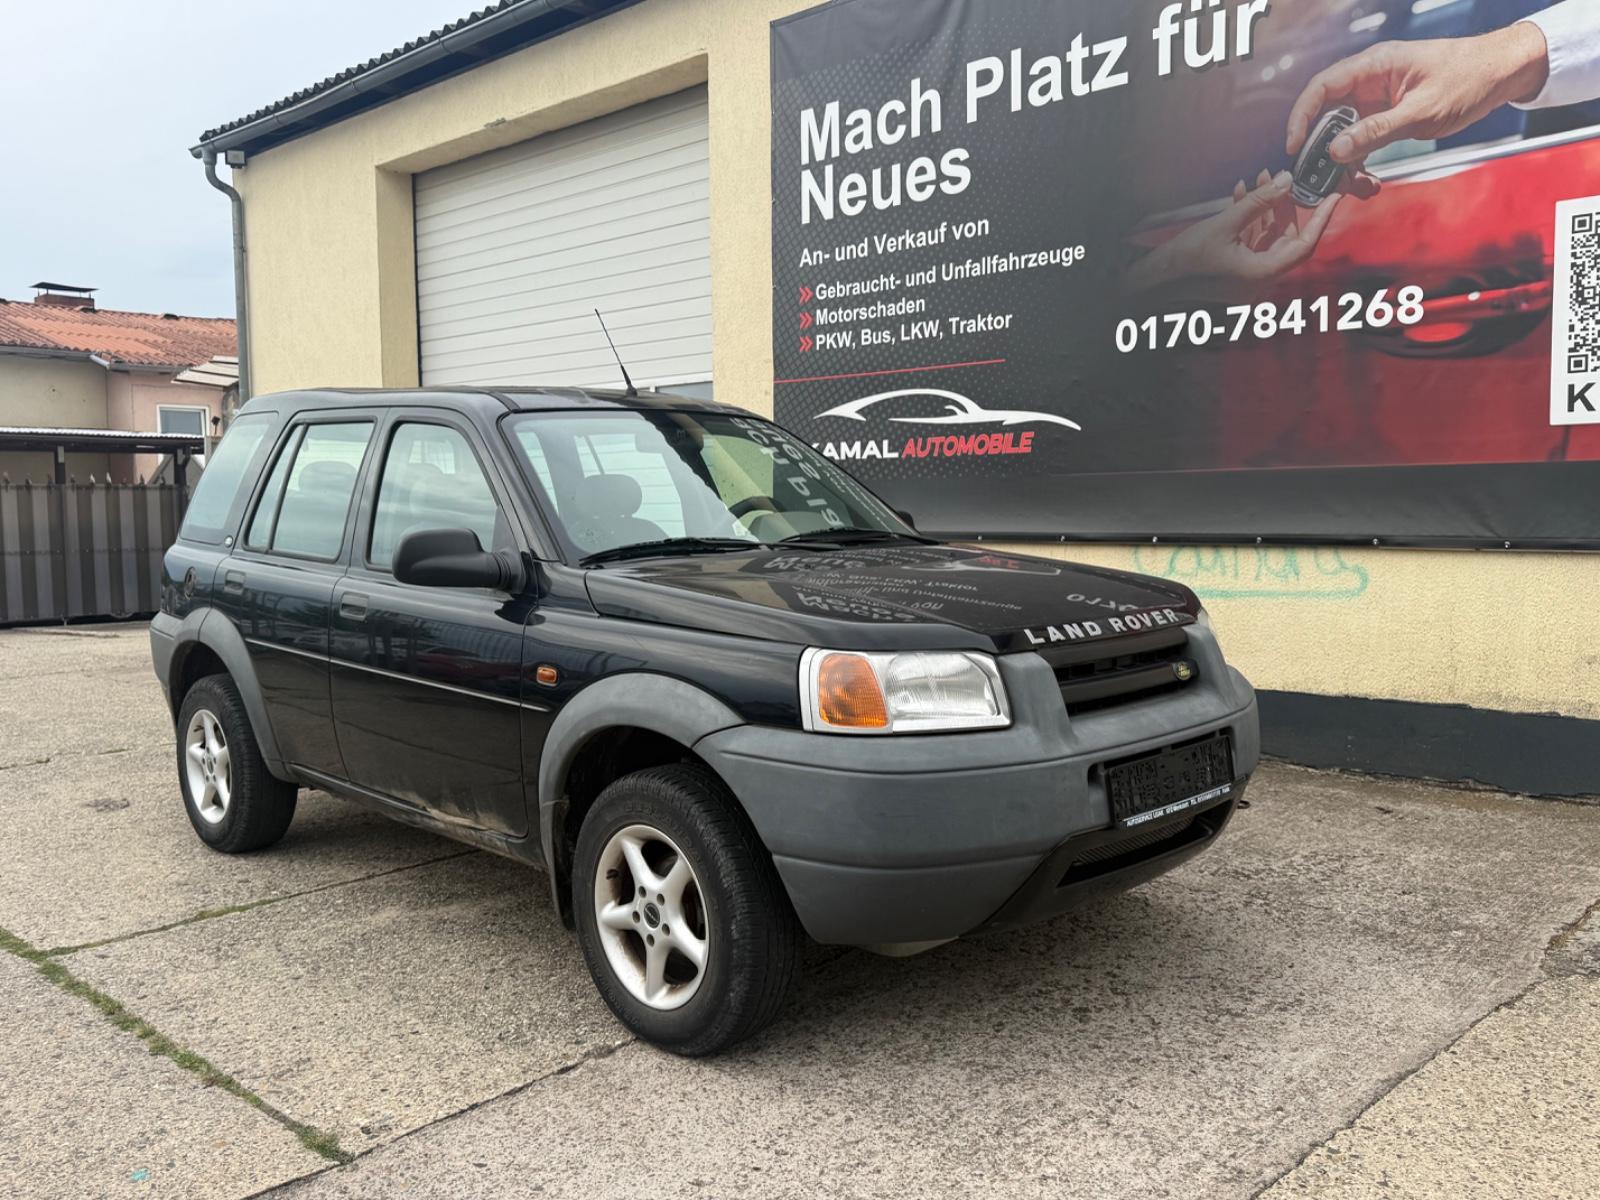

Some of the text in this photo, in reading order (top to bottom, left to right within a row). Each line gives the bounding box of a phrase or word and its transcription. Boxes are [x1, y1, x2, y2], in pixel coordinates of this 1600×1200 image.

[801, 0, 1268, 165] Mach Platz für
[801, 147, 971, 225] Neues
[799, 218, 990, 268] An- und Verkauf von
[815, 244, 1086, 301] Gebraucht- und Unfallfahrzeuge
[815, 298, 925, 326] Motorschaden
[816, 312, 1013, 351] PKW, Bus, LKW, Traktor
[1115, 284, 1425, 353] 0170-7841268
[811, 431, 1035, 461] AMAL AUTOMOBILE
[1023, 608, 1180, 645] LAND ROVER
